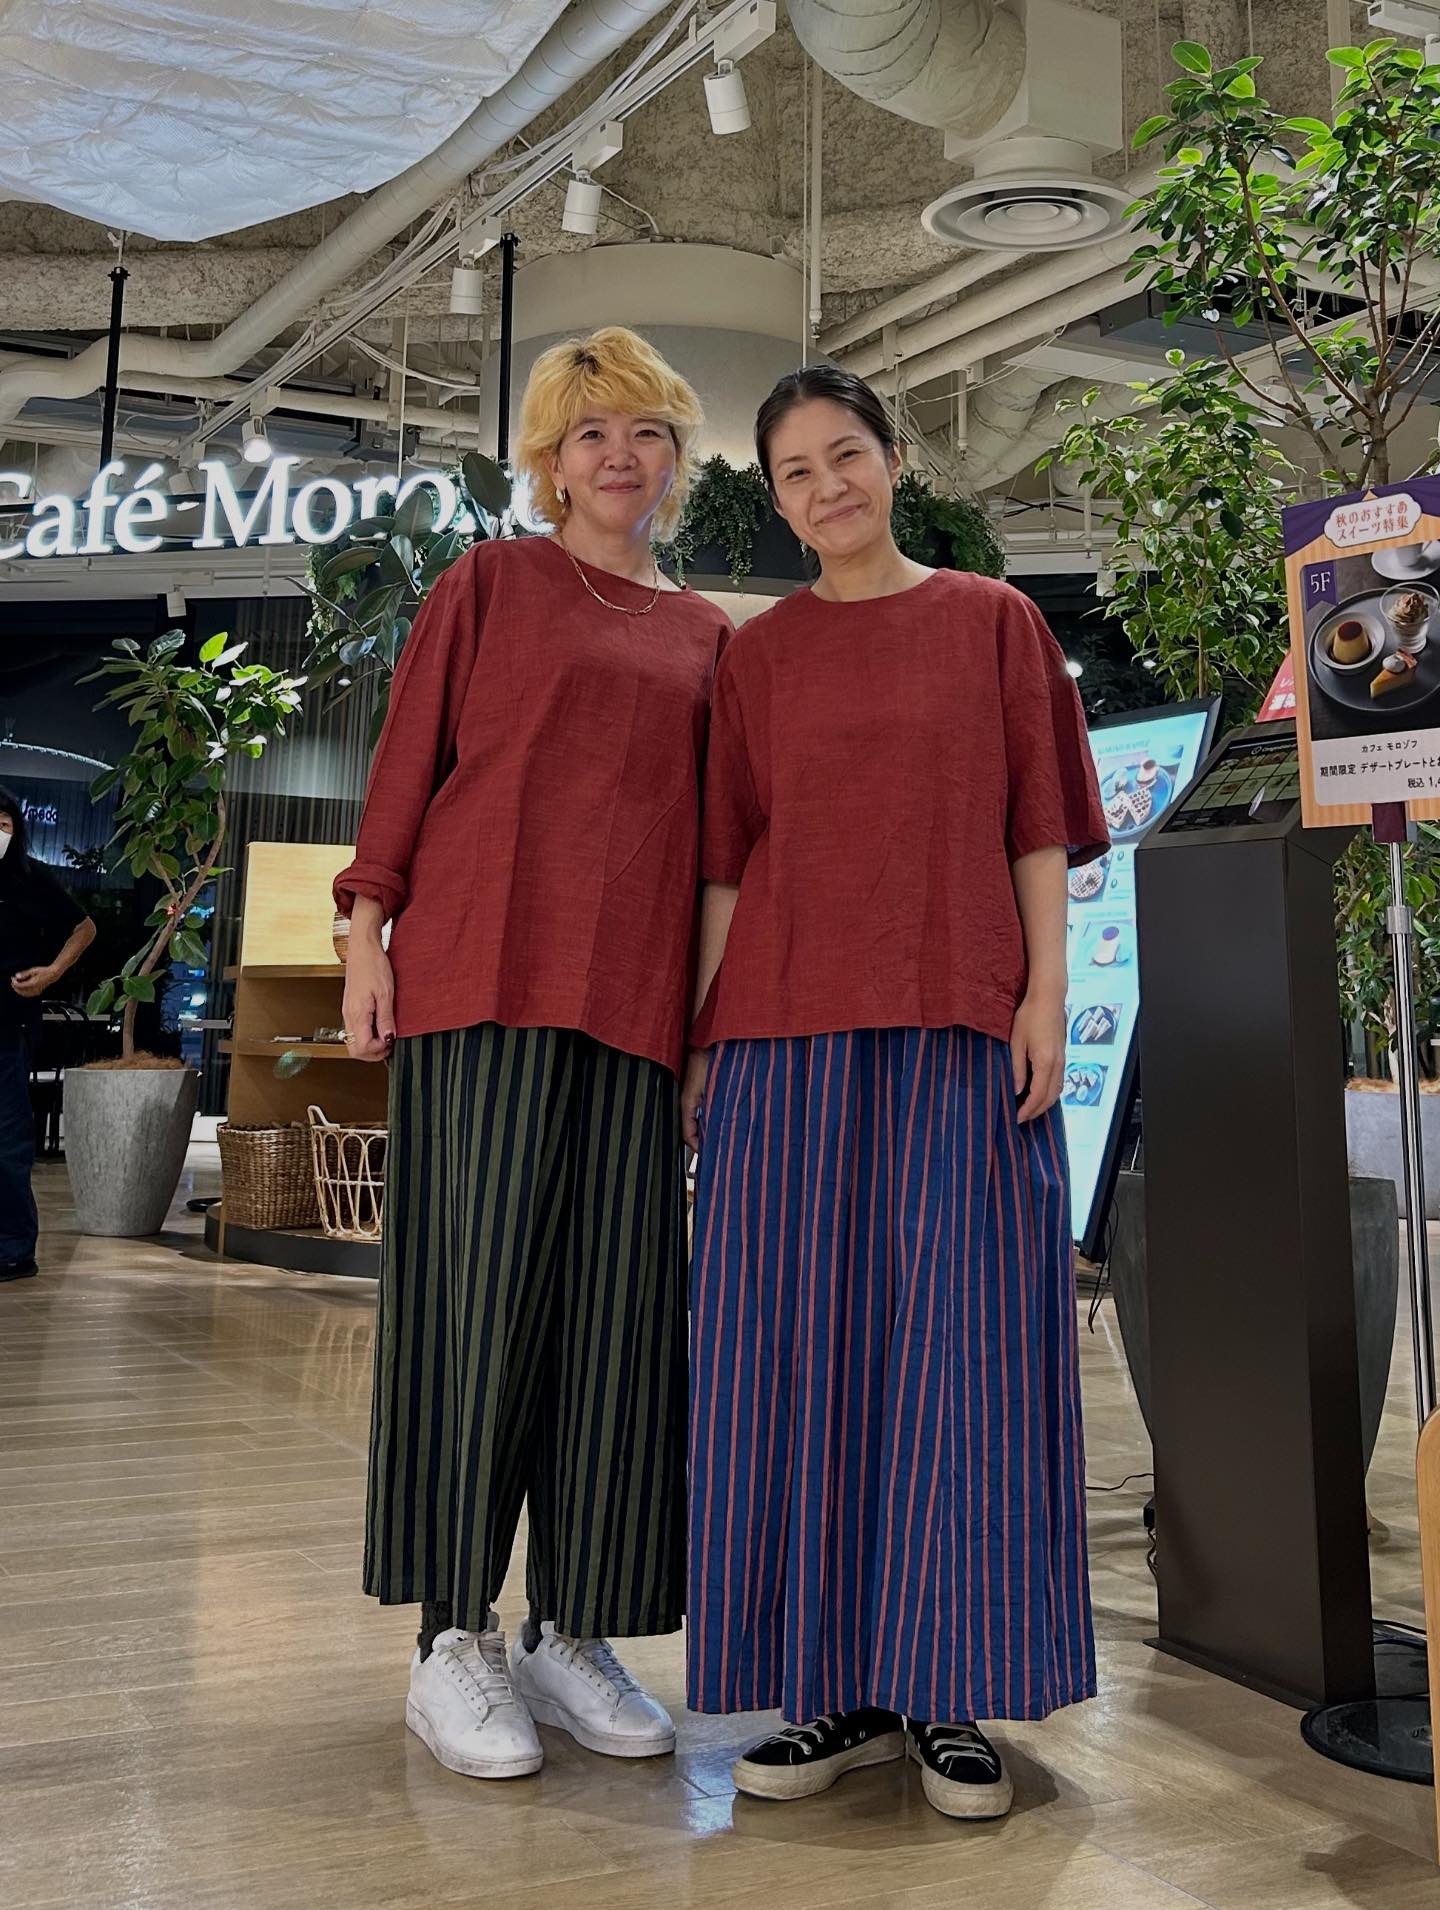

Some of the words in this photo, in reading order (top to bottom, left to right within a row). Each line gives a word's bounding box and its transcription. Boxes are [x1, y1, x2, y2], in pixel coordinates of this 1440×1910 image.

[1336, 501, 1408, 527] 秋のおすすめ
[1338, 515, 1408, 540] スイーツ特集
[1310, 571, 1331, 594] 5F
[1361, 744, 1383, 753] カフェ
[1386, 739, 1418, 751] モロゾフ
[1319, 764, 1357, 777] 期間限定
[1407, 777, 1425, 789] 税込
